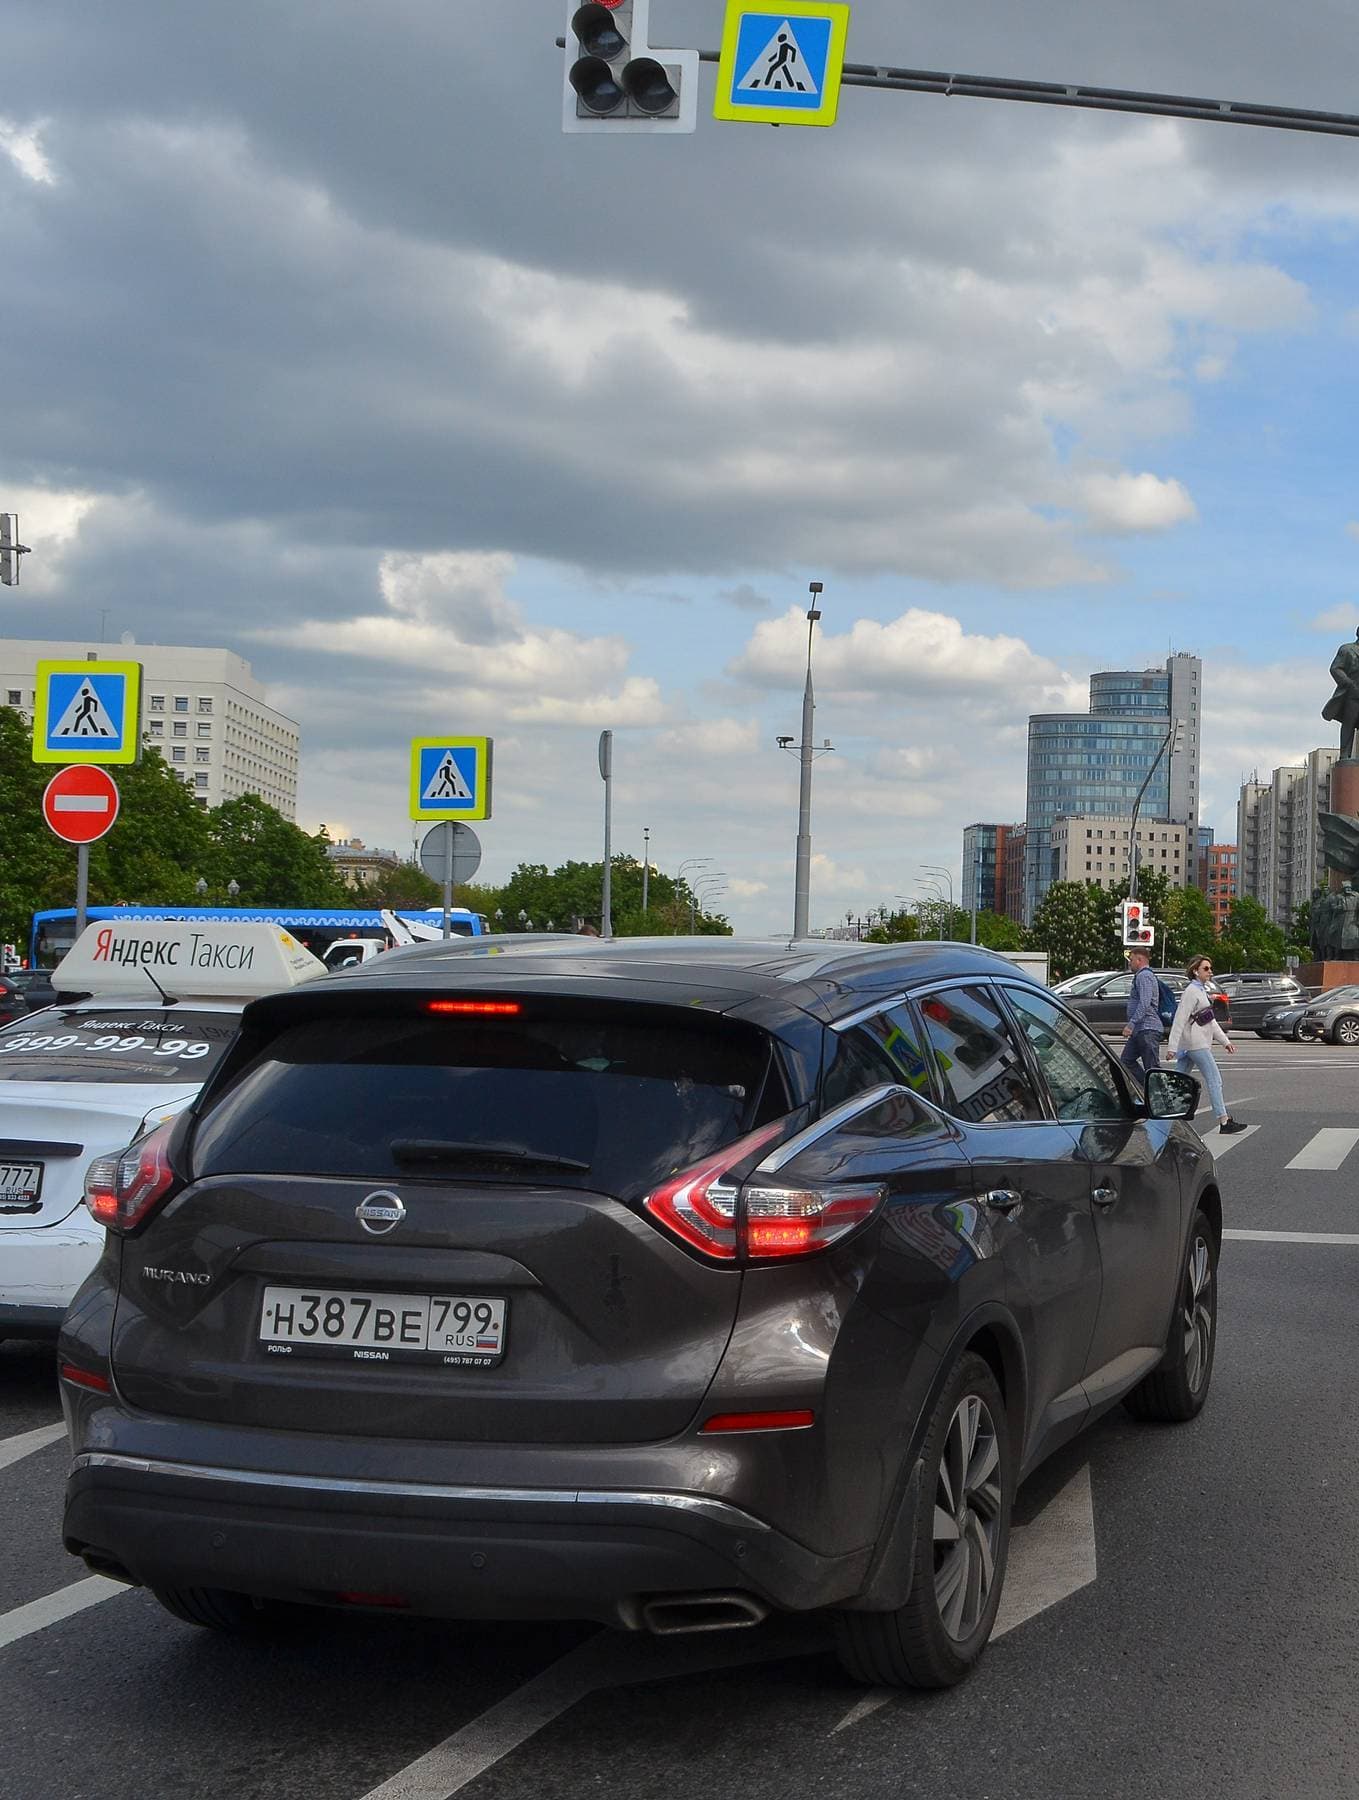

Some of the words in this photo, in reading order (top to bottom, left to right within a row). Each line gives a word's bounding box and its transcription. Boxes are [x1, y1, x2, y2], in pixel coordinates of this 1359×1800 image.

[92, 928, 182, 967] Яндекс
[190, 933, 255, 970] Такси
[77, 1019, 137, 1030] Яндекс
[137, 1020, 186, 1033] Такси
[0, 1035, 210, 1060] 999-99-99
[1, 1167, 33, 1186] 777
[357, 1207, 401, 1219] NISSAN
[142, 1266, 211, 1285] MURANO
[433, 1300, 495, 1335] 799
[445, 1334, 475, 1347] RUS
[354, 1350, 390, 1360] NISSAN
